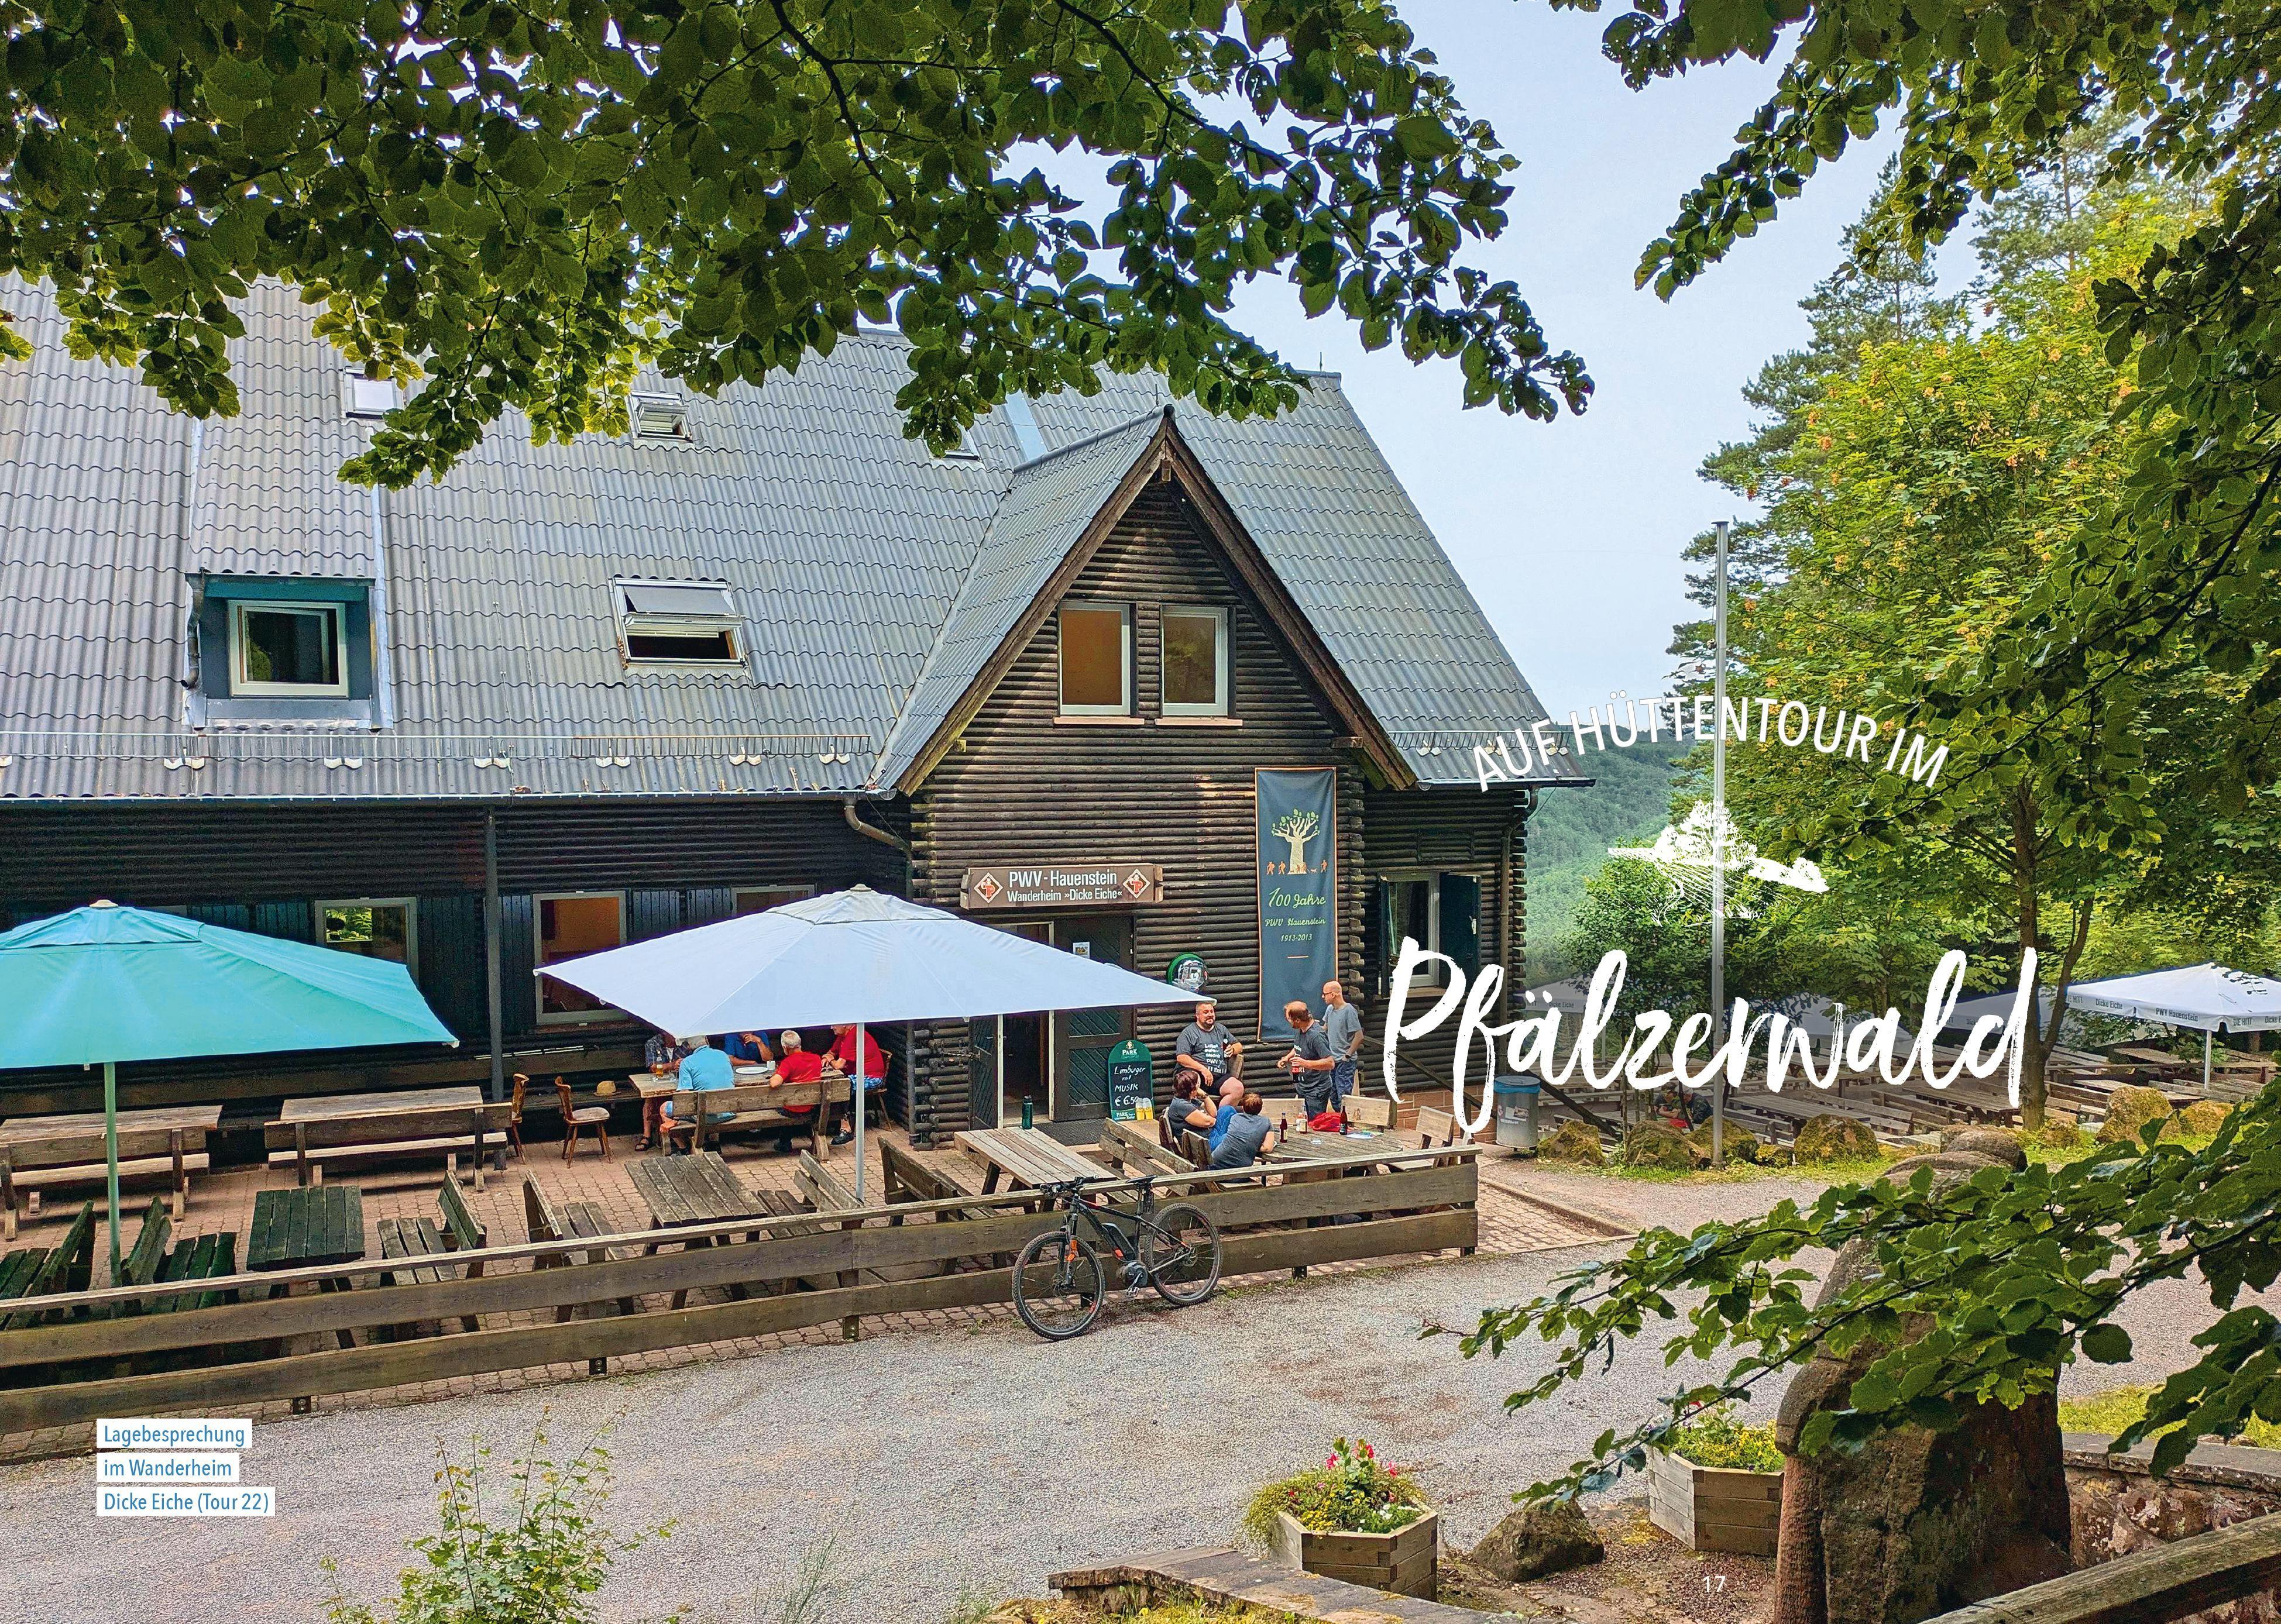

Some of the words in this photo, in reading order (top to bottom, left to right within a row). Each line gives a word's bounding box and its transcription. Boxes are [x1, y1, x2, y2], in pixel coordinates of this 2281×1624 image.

[1006, 889, 1062, 902] Wanderheim
[1269, 887, 1291, 907] 100
[1293, 893, 1327, 909] Jahre
[1287, 917, 1326, 926] Hauenstein
[1281, 933, 1313, 942] 1913-2013
[2096, 998, 2109, 1007] Dicke
[2110, 1000, 2123, 1010] Eiche
[2169, 1009, 2198, 1022] Hauenstein
[1114, 1065, 1146, 1076] Limburger
[1114, 1083, 1138, 1092] MUSIK
